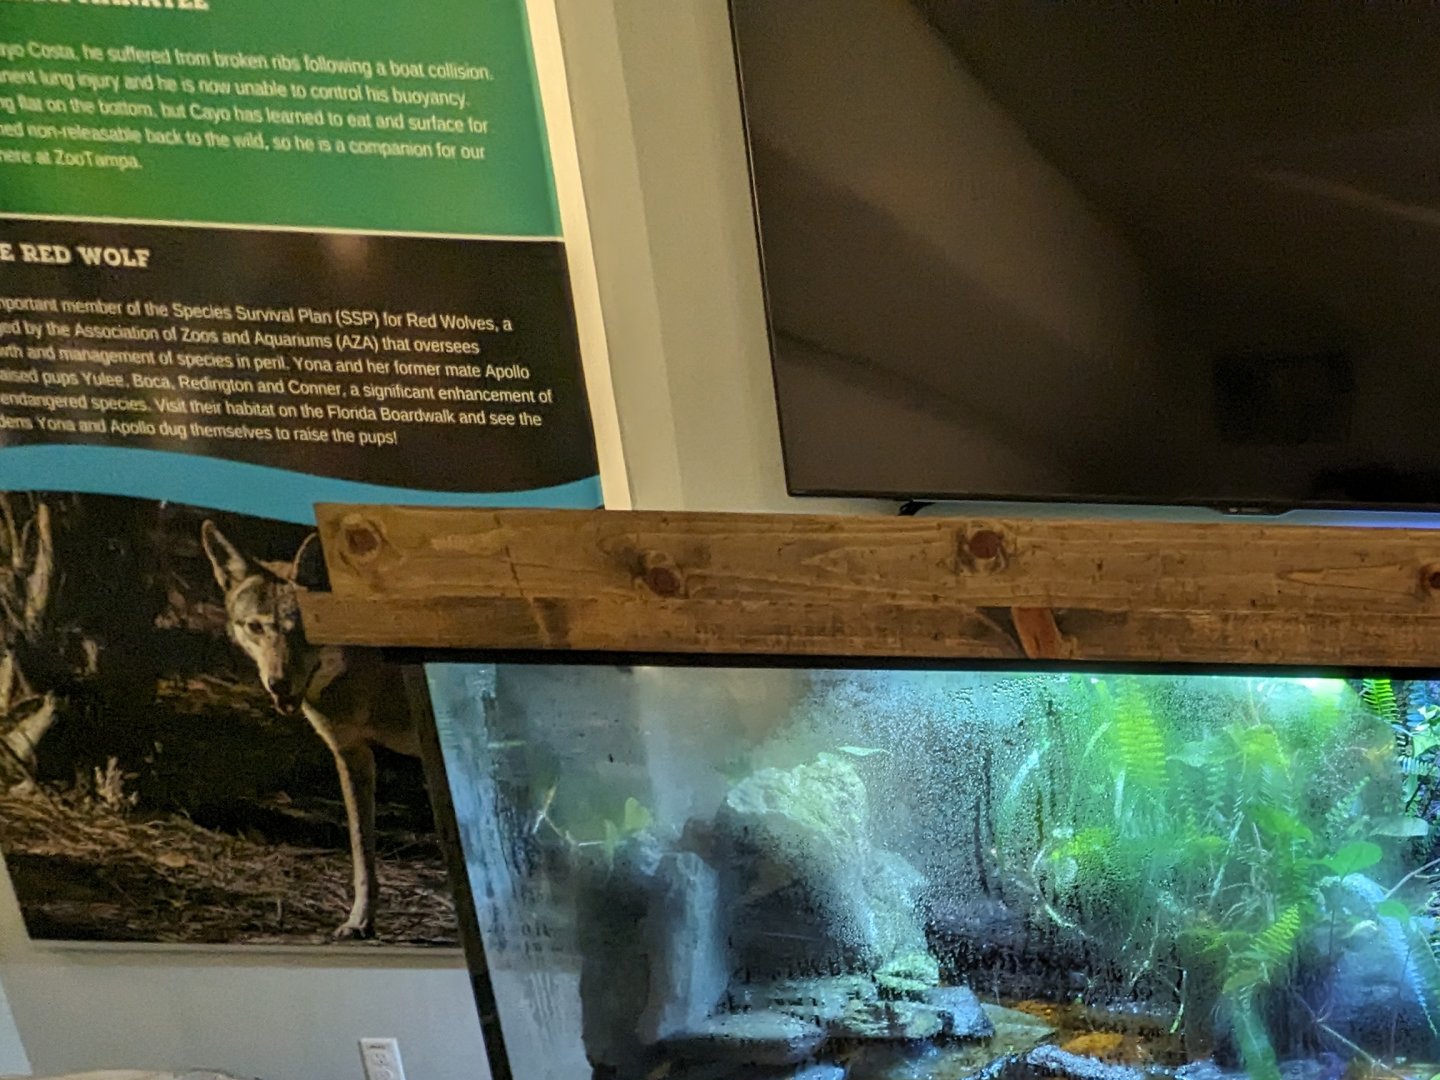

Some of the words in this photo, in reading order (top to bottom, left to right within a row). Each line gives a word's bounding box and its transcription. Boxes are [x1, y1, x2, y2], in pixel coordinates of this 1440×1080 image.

[82, 44, 102, 61] he
[107, 45, 170, 65] suffered
[175, 48, 210, 66] from
[213, 51, 267, 69] broken
[272, 54, 300, 72] ribs
[304, 54, 373, 79] following
[376, 61, 386, 76] a
[389, 60, 424, 78] boat
[39, 69, 75, 91] lung
[77, 71, 119, 93] injury
[123, 74, 153, 91] and
[156, 74, 177, 92] he
[182, 78, 195, 94] is
[199, 79, 231, 95] now
[235, 80, 286, 98] unable
[291, 83, 306, 99] to
[310, 85, 362, 101] control
[365, 85, 388, 103] his
[17, 94, 43, 112] flat
[46, 98, 67, 113] on
[69, 97, 95, 114] the
[160, 102, 186, 119] but
[190, 102, 230, 124] Cayo
[234, 105, 262, 123] has
[266, 107, 324, 126] learned
[327, 112, 343, 127] to
[347, 113, 371, 128] eat
[375, 113, 404, 130] and
[408, 115, 464, 133] surface
[466, 117, 488, 133] for
[27, 124, 142, 143] non-releasable
[145, 127, 183, 145] back
[186, 131, 202, 146] to
[204, 130, 231, 148] the
[233, 132, 270, 151] wild,
[272, 136, 291, 151] so
[294, 135, 314, 152] he
[318, 139, 331, 152] is
[335, 140, 345, 153] a
[349, 140, 433, 158] companion
[437, 142, 456, 158] for
[460, 146, 485, 159] our
[19, 243, 72, 264] RED
[76, 246, 150, 267] WOLF
[61, 299, 122, 315] member
[127, 300, 141, 316] of
[146, 301, 168, 317] the
[172, 302, 231, 321] Species
[236, 305, 294, 323] Survival
[297, 308, 332, 324] Plan
[336, 309, 379, 329] (SSP)
[383, 311, 402, 327] for
[407, 312, 437, 328] Red
[440, 314, 499, 332] Wolves,
[502, 319, 513, 331] a
[23, 320, 42, 339] by
[46, 321, 70, 337] the
[75, 322, 159, 341] Association
[162, 326, 177, 341] of
[181, 327, 218, 343] Zoos
[222, 330, 250, 345] and
[254, 331, 332, 349] Aquariums
[336, 334, 379, 353] (AZA)
[382, 336, 410, 351] that
[414, 340, 480, 354] oversees
[27, 344, 55, 361] and
[59, 347, 156, 366] management
[159, 350, 173, 365] of
[177, 353, 233, 368] species
[237, 354, 250, 368] in
[255, 355, 290, 372] peril.
[292, 356, 332, 372] Yona
[336, 358, 363, 373] and
[366, 358, 390, 374] her
[394, 360, 441, 376] former
[445, 364, 481, 378] mate
[485, 364, 530, 381] Apollo
[41, 371, 79, 387] pups
[179, 375, 254, 395] Redington
[257, 379, 285, 394] and
[288, 379, 347, 397] Conner,
[350, 384, 360, 397] a
[363, 383, 436, 401] significant
[438, 386, 535, 403] enhancement
[539, 389, 553, 403] of
[0, 392, 87, 411] endangered
[91, 397, 150, 413] species.
[154, 397, 187, 414] Visit
[190, 399, 222, 414] their
[225, 400, 276, 417] habitat
[278, 405, 297, 417] on
[300, 403, 323, 419] the
[327, 404, 377, 421] Florida
[380, 407, 455, 423] Boardwalk
[459, 410, 486, 424] and
[490, 413, 516, 426] see
[519, 412, 542, 426] the
[36, 416, 76, 432] Yona
[78, 418, 107, 433] and
[110, 419, 156, 436] Apollo
[159, 420, 188, 440] dug
[190, 422, 272, 440] themselves
[275, 427, 290, 440] to
[293, 427, 328, 442] raise
[332, 428, 355, 443] the
[358, 431, 398, 446] pups!
